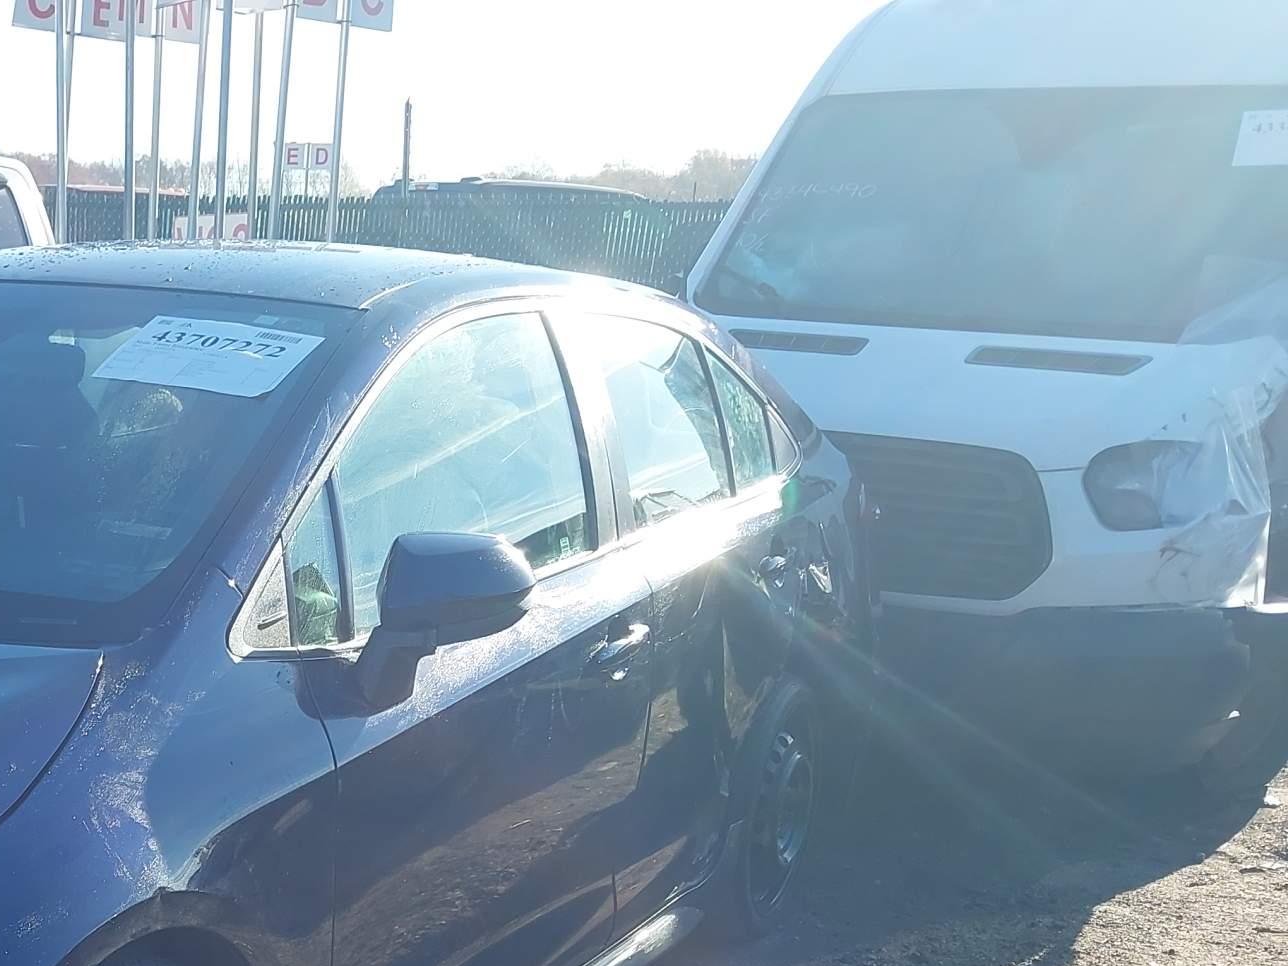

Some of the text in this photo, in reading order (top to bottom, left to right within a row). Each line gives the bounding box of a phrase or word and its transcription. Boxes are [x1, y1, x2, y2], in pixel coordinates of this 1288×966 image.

[287, 148, 298, 165] E
[315, 148, 328, 165] D
[151, 330, 287, 358] 43707272
